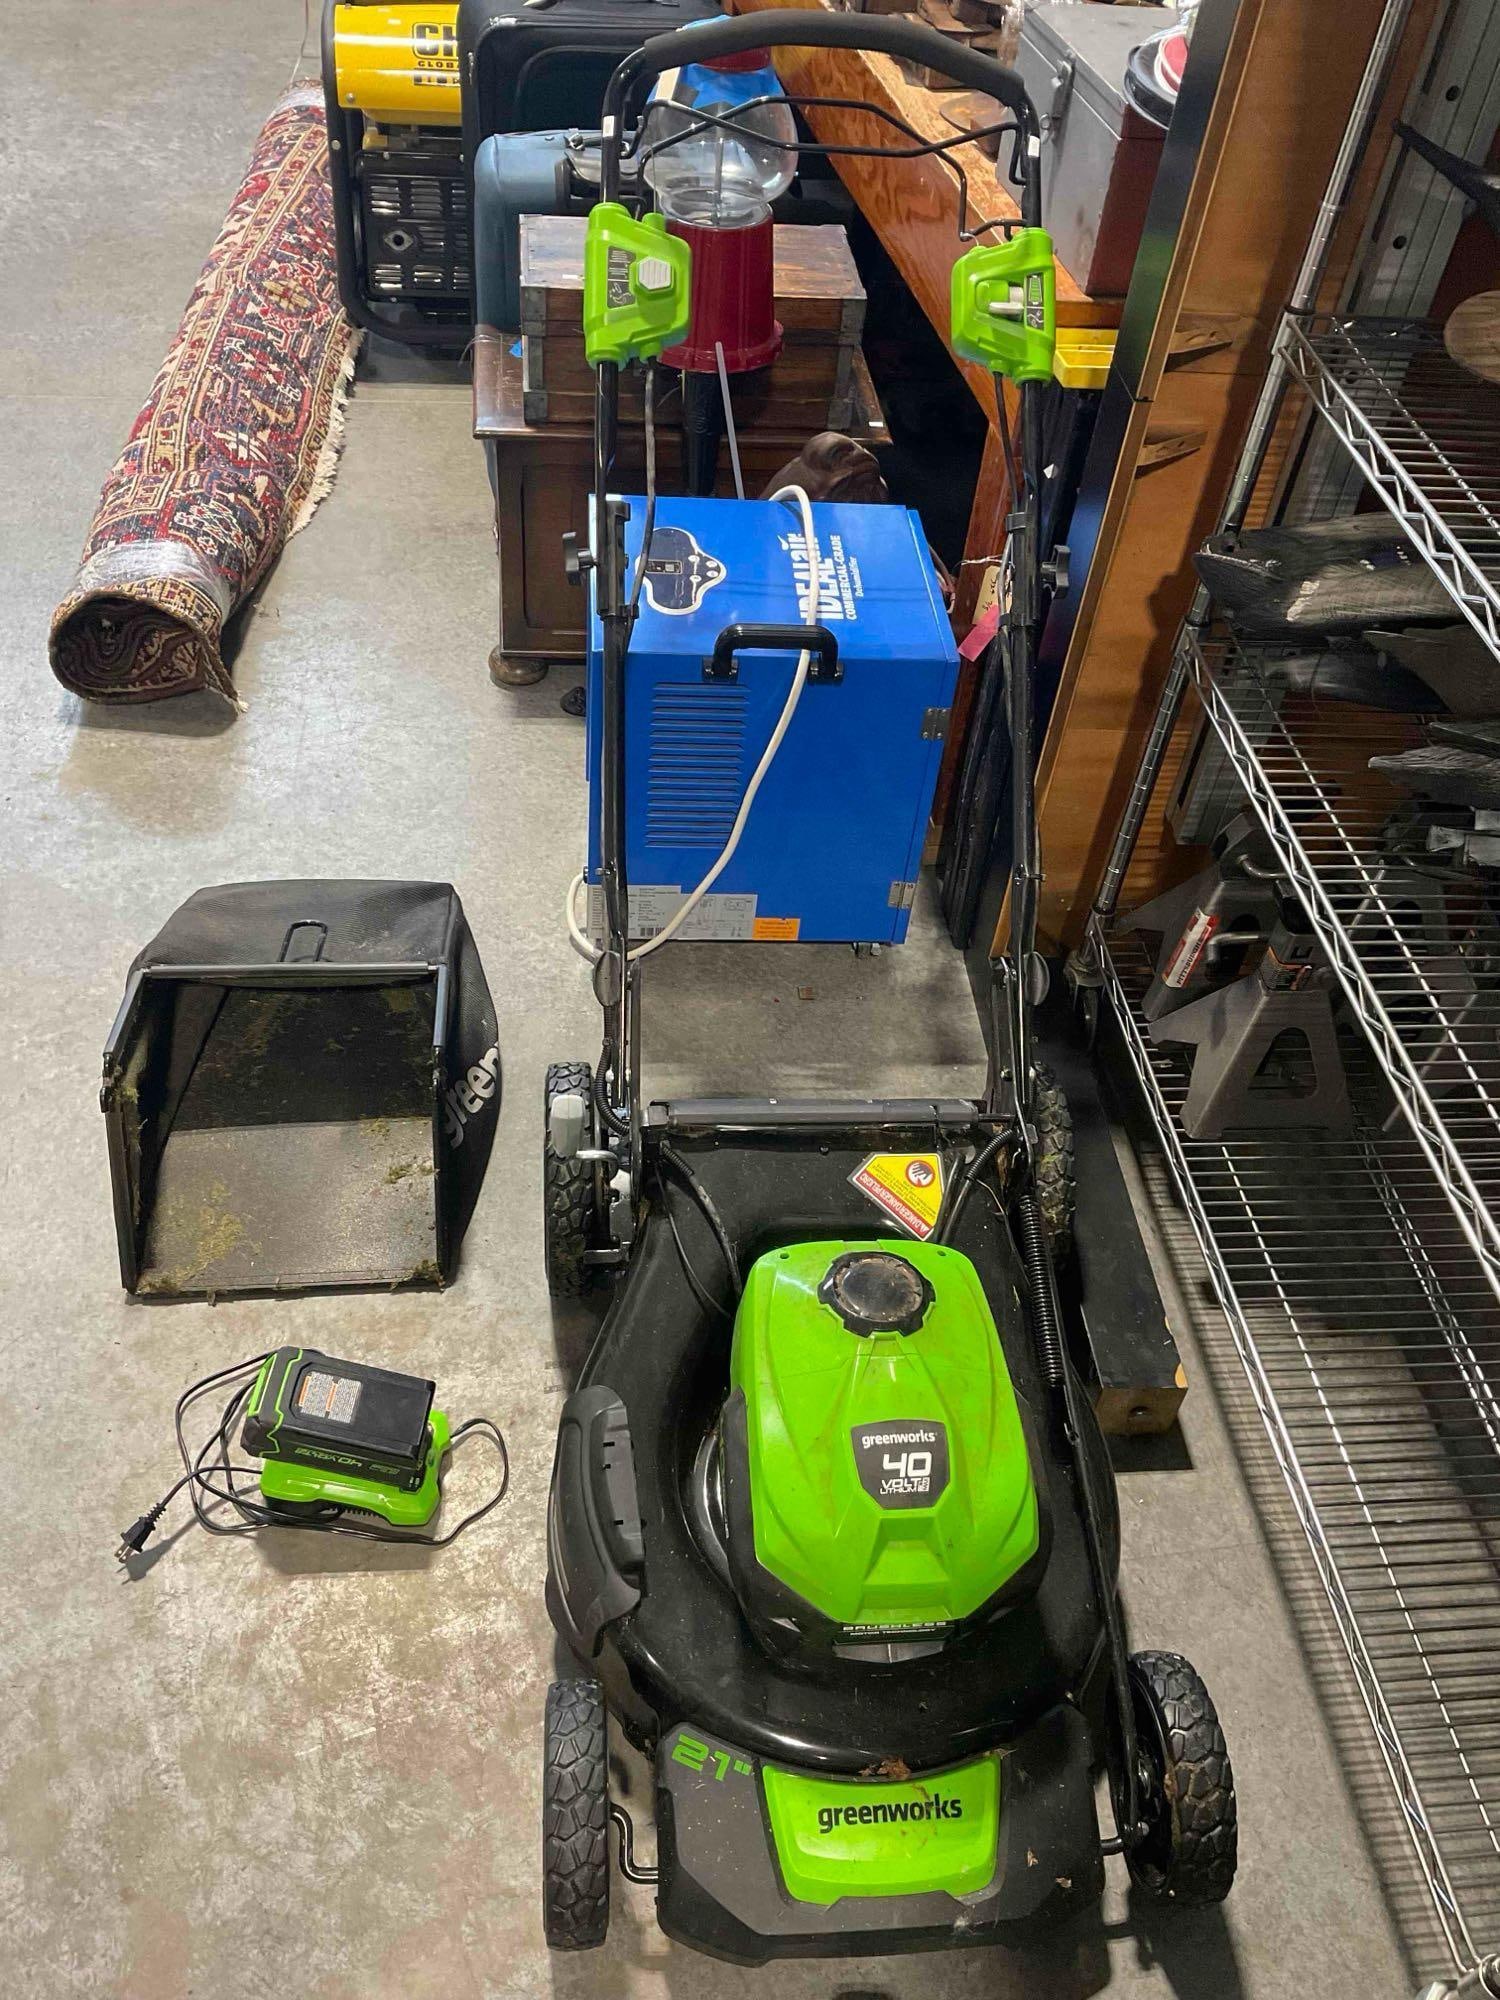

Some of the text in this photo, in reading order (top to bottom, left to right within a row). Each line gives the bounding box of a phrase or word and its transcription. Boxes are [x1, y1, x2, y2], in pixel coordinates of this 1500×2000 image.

[415, 24, 457, 56] CH
[829, 534, 857, 621] COMMERCIAL-GRADE
[445, 1043, 499, 1149] green
[861, 1429, 936, 1449] greenworks
[882, 1451, 932, 1478] 40
[881, 1478, 922, 1489] VOLT
[672, 1734, 751, 1781] 21"
[818, 1793, 963, 1834] greenworks
